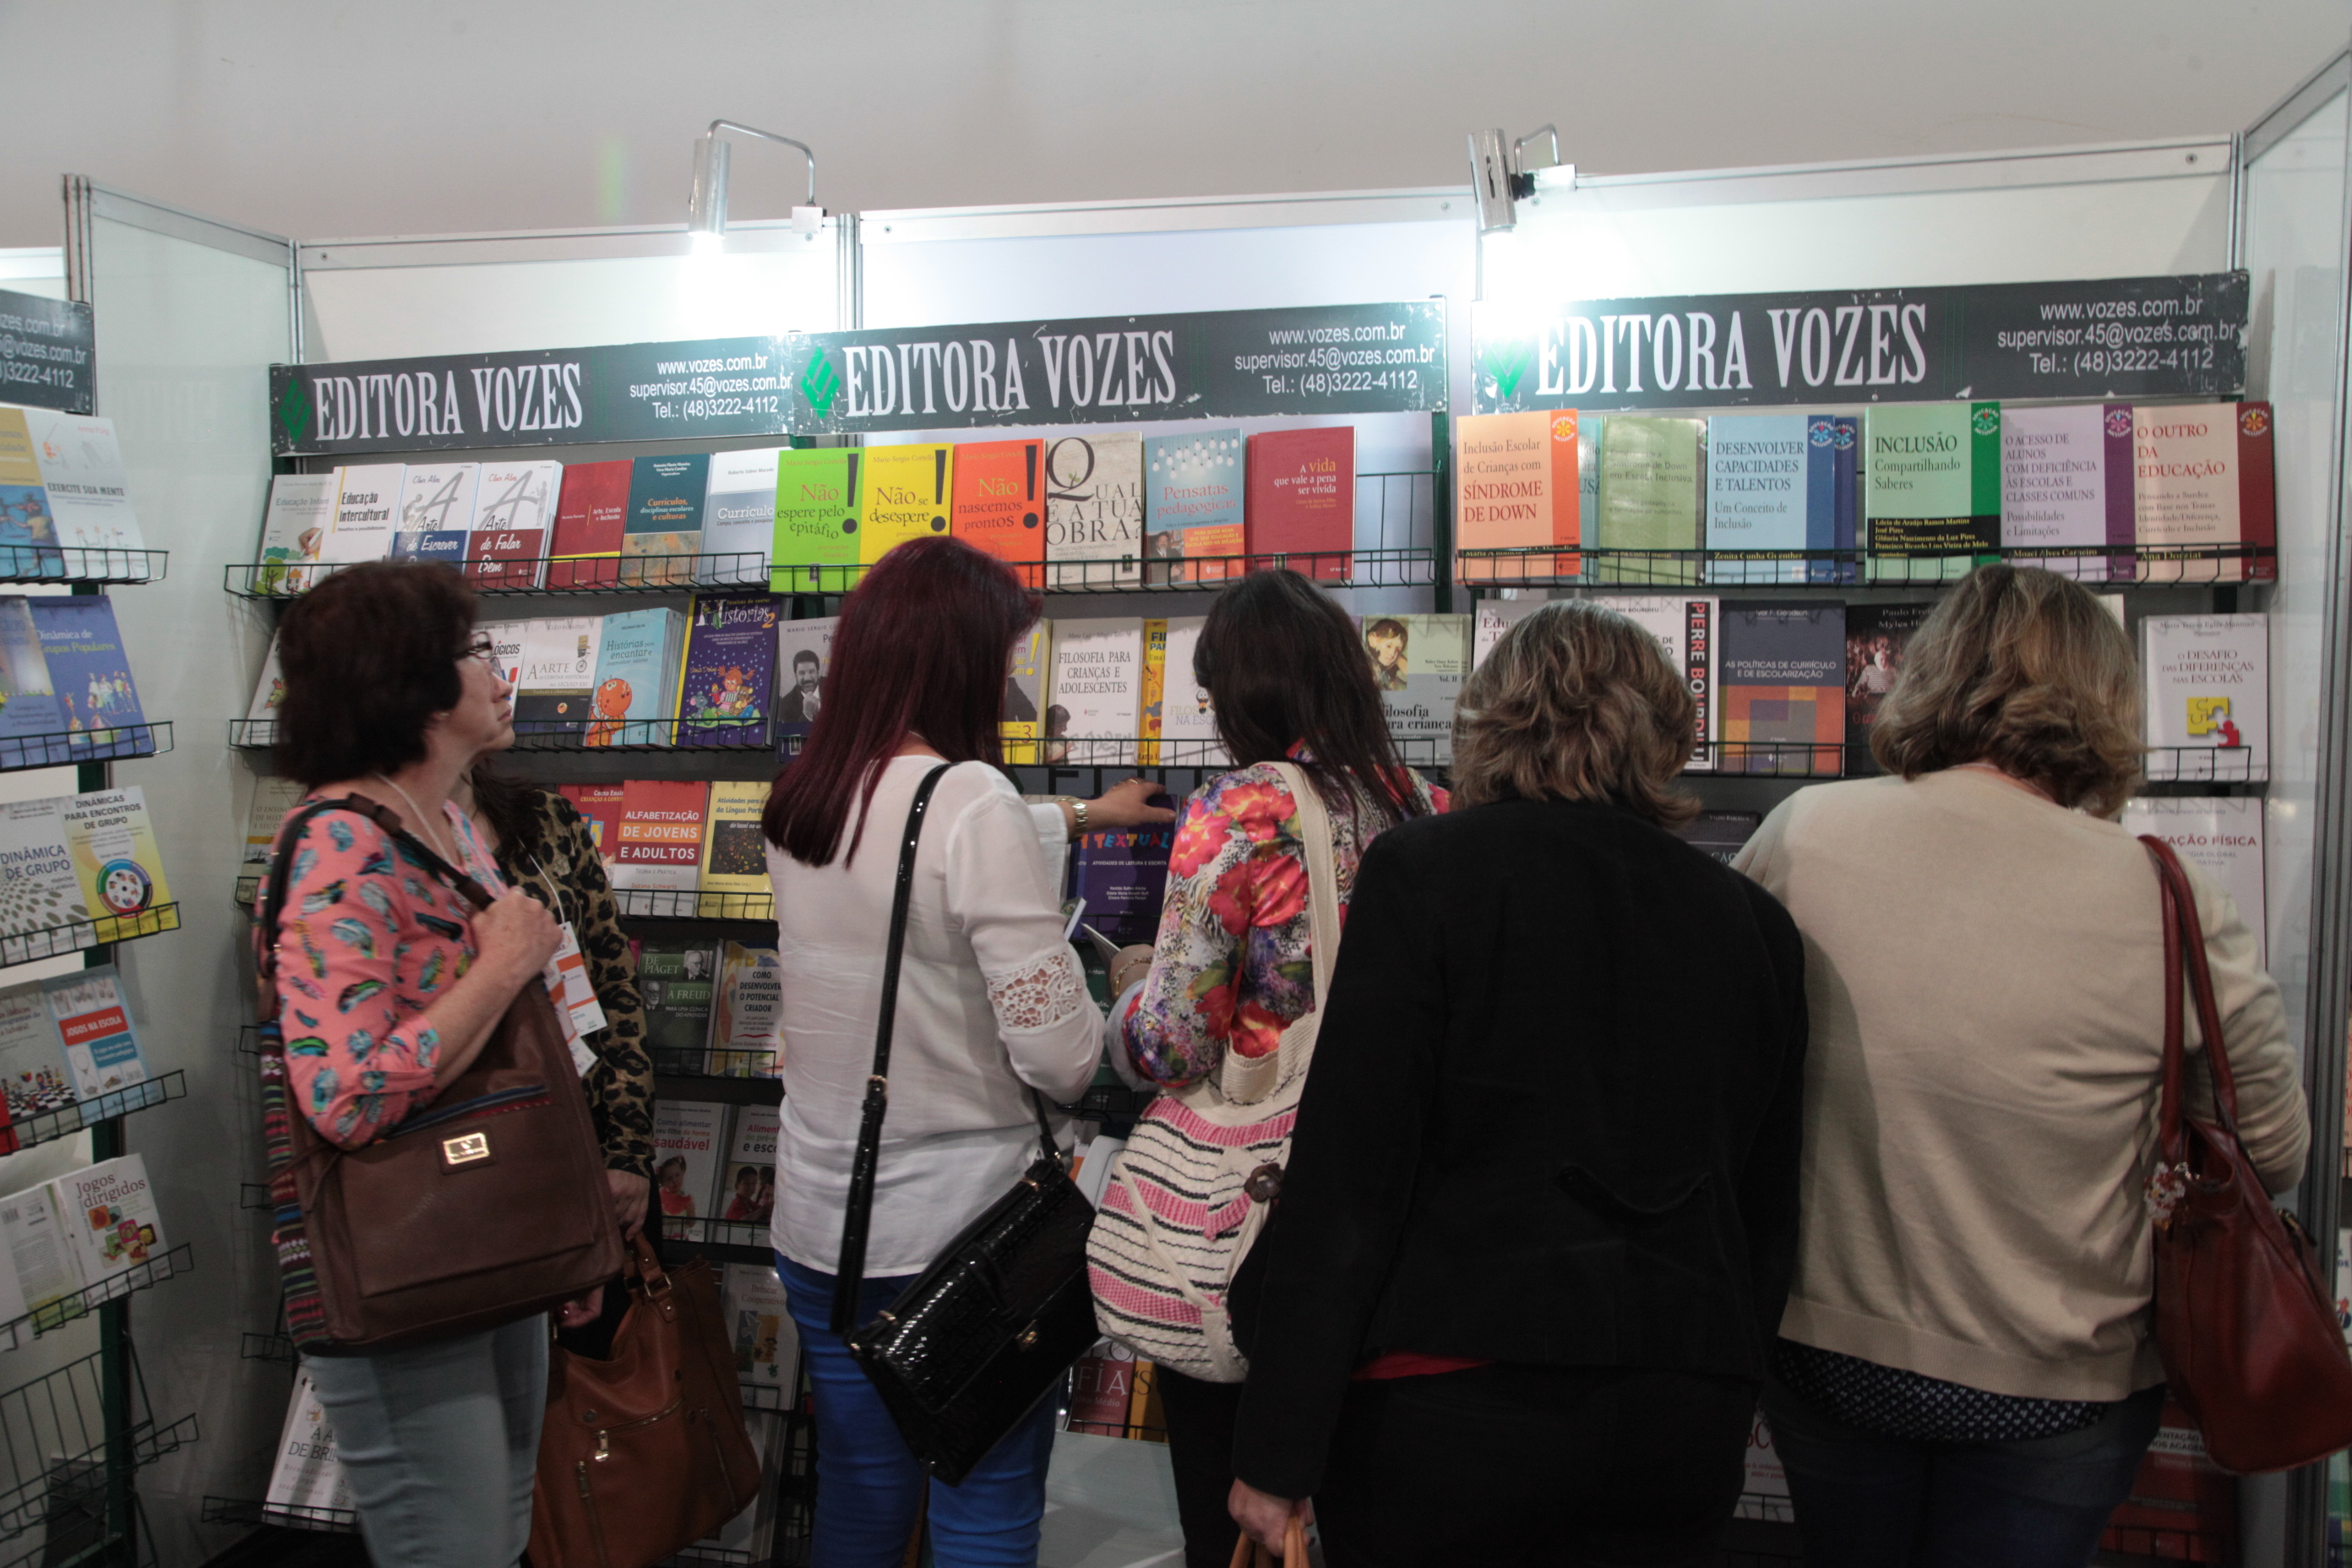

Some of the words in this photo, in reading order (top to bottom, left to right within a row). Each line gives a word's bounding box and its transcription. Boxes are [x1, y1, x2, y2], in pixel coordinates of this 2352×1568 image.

[2040, 294, 2202, 321] www.vozes.com.br
[1269, 323, 1405, 345] www.vozes.com.br
[1997, 323, 2236, 349] supervisor.45@vozes.com.br
[1535, 310, 1753, 395] EDITORA
[1767, 304, 1926, 386] VOZES
[657, 354, 767, 376] www.vozes.com.br
[1234, 345, 1435, 373] supervisor.45@vozes.com.br
[2029, 353, 2068, 373] Tel.:
[2073, 347, 2213, 373] (48)3222-4112
[843, 339, 1030, 417] EDITORA
[1038, 330, 1176, 409] VOZES
[629, 373, 792, 399] supervisor.45@vozes.com.br
[1262, 375, 1295, 396] Tel.:
[1299, 371, 1418, 396] (48)3222-4112
[313, 370, 464, 441] EDITORA
[471, 363, 583, 432] VOZES
[652, 402, 679, 419] Tel.:
[683, 396, 778, 421] (48)3222-4112
[2137, 427, 2148, 439] O
[2153, 423, 2208, 438] OUTRO
[1464, 441, 1503, 455] Inclusão
[1506, 439, 1541, 452] Escolar
[1716, 442, 1805, 455] DESENVOLVER
[1876, 431, 1957, 454] INCLUSÃO
[873, 455, 890, 464] Mario
[892, 455, 910, 463] Sergio
[912, 454, 934, 462] Cortella
[2006, 448, 2045, 460] ALUNOS
[2137, 445, 2158, 459] DA
[1300, 464, 1307, 474] A
[1309, 458, 1337, 472] vida
[1463, 463, 1475, 474] de
[1478, 461, 1518, 475] Crianças
[1522, 461, 1541, 471] com
[1716, 460, 1799, 473] CAPACIDADES
[1876, 458, 1961, 476] Compartilhando
[2006, 462, 2029, 474] COM
[2031, 460, 2097, 473] DEFICIÊNCIA
[2138, 460, 2225, 479] EDUCAÇÃO
[978, 477, 1019, 498] Não
[1274, 476, 1289, 487] que
[1291, 475, 1308, 485] vale
[1316, 474, 1337, 485] pena
[1715, 479, 1723, 491] E
[1725, 477, 1791, 491] TALENTOS
[1876, 477, 1914, 490] Saberes
[48, 483, 81, 493] EXERCITE
[84, 486, 98, 494] SUA
[101, 487, 124, 496] MENTE
[800, 483, 840, 502] Não
[876, 487, 916, 506] Não
[918, 496, 928, 505] se
[1163, 483, 1229, 500] Pensatas
[1298, 485, 1310, 495] ser
[1312, 483, 1337, 494] vivida
[1464, 480, 1543, 500] SÍNDROME
[2006, 490, 2049, 502] CLASSES
[2050, 489, 2094, 501] COMUNS
[341, 492, 378, 506] Educação
[647, 497, 688, 507] Currículos,
[640, 506, 668, 514] disciplinas
[717, 505, 774, 520] Currículo
[777, 507, 816, 521] espere
[819, 505, 845, 520] pelo
[958, 501, 1023, 514] nascemos
[1157, 498, 1237, 520] pedagógicas
[1464, 507, 1485, 522] DE
[1489, 504, 1537, 522] DOWN
[1715, 502, 1732, 514] Um
[1734, 502, 1774, 514] Conceito
[1776, 502, 1787, 513] de
[416, 516, 438, 531] Arte
[484, 515, 508, 531] Arte
[869, 509, 929, 527] desespere
[964, 514, 1015, 532] prontos
[2007, 510, 2065, 522] Possibilidades
[790, 520, 839, 540] epitáfio
[1046, 517, 1141, 546] OBRA?
[1714, 518, 1751, 530] Inclusão
[406, 537, 418, 552] de
[421, 535, 458, 552] Escrever
[481, 536, 492, 551] de
[495, 534, 521, 550] Falar
[1059, 651, 1104, 664] FILOSOFIA
[1108, 651, 1130, 662] PARA
[2187, 650, 2238, 660] DESAFIO
[527, 664, 538, 680] A
[540, 662, 569, 672] ARTE
[1725, 661, 1735, 669] AS
[1737, 658, 1776, 669] POLÍTICAS
[1790, 658, 1837, 669] CURRÍCULO
[2180, 661, 2254, 674] DIFERENÇAS
[1068, 667, 1111, 681] CRIANÇAS
[1114, 667, 1120, 678] E
[2191, 673, 2243, 684] ESCOLAS
[1059, 682, 1127, 694] ADOLESCENTES
[1407, 718, 1452, 731] criança
[75, 795, 124, 808] DINÂMICAS
[65, 811, 88, 820] PARA
[90, 803, 141, 818] ENCONTROS
[625, 810, 700, 820] ALFABETIZAÇÃO
[98, 816, 128, 827] GRUPO
[623, 826, 640, 837] DE
[644, 826, 698, 838] JOVENS
[1094, 832, 1169, 849] TEXTUAL
[1, 845, 66, 864] DINÂMICA
[620, 847, 629, 858] E
[632, 847, 695, 860] ADULTOS
[5, 868, 22, 880] DE
[26, 859, 70, 876] GRUPO
[645, 956, 659, 966] DE
[645, 965, 680, 974] PIAGET
[667, 990, 674, 999] A
[677, 990, 710, 999] FREUD
[744, 1004, 772, 1012] CRIADOR
[66, 1025, 88, 1037] JOGOS
[88, 1021, 98, 1032] NA
[98, 1015, 122, 1029] ESCOLA
[656, 1118, 677, 1126] Como
[654, 1137, 710, 1151] saudável
[76, 1174, 116, 1199] Jogos
[84, 1179, 146, 1208] dirigidos
